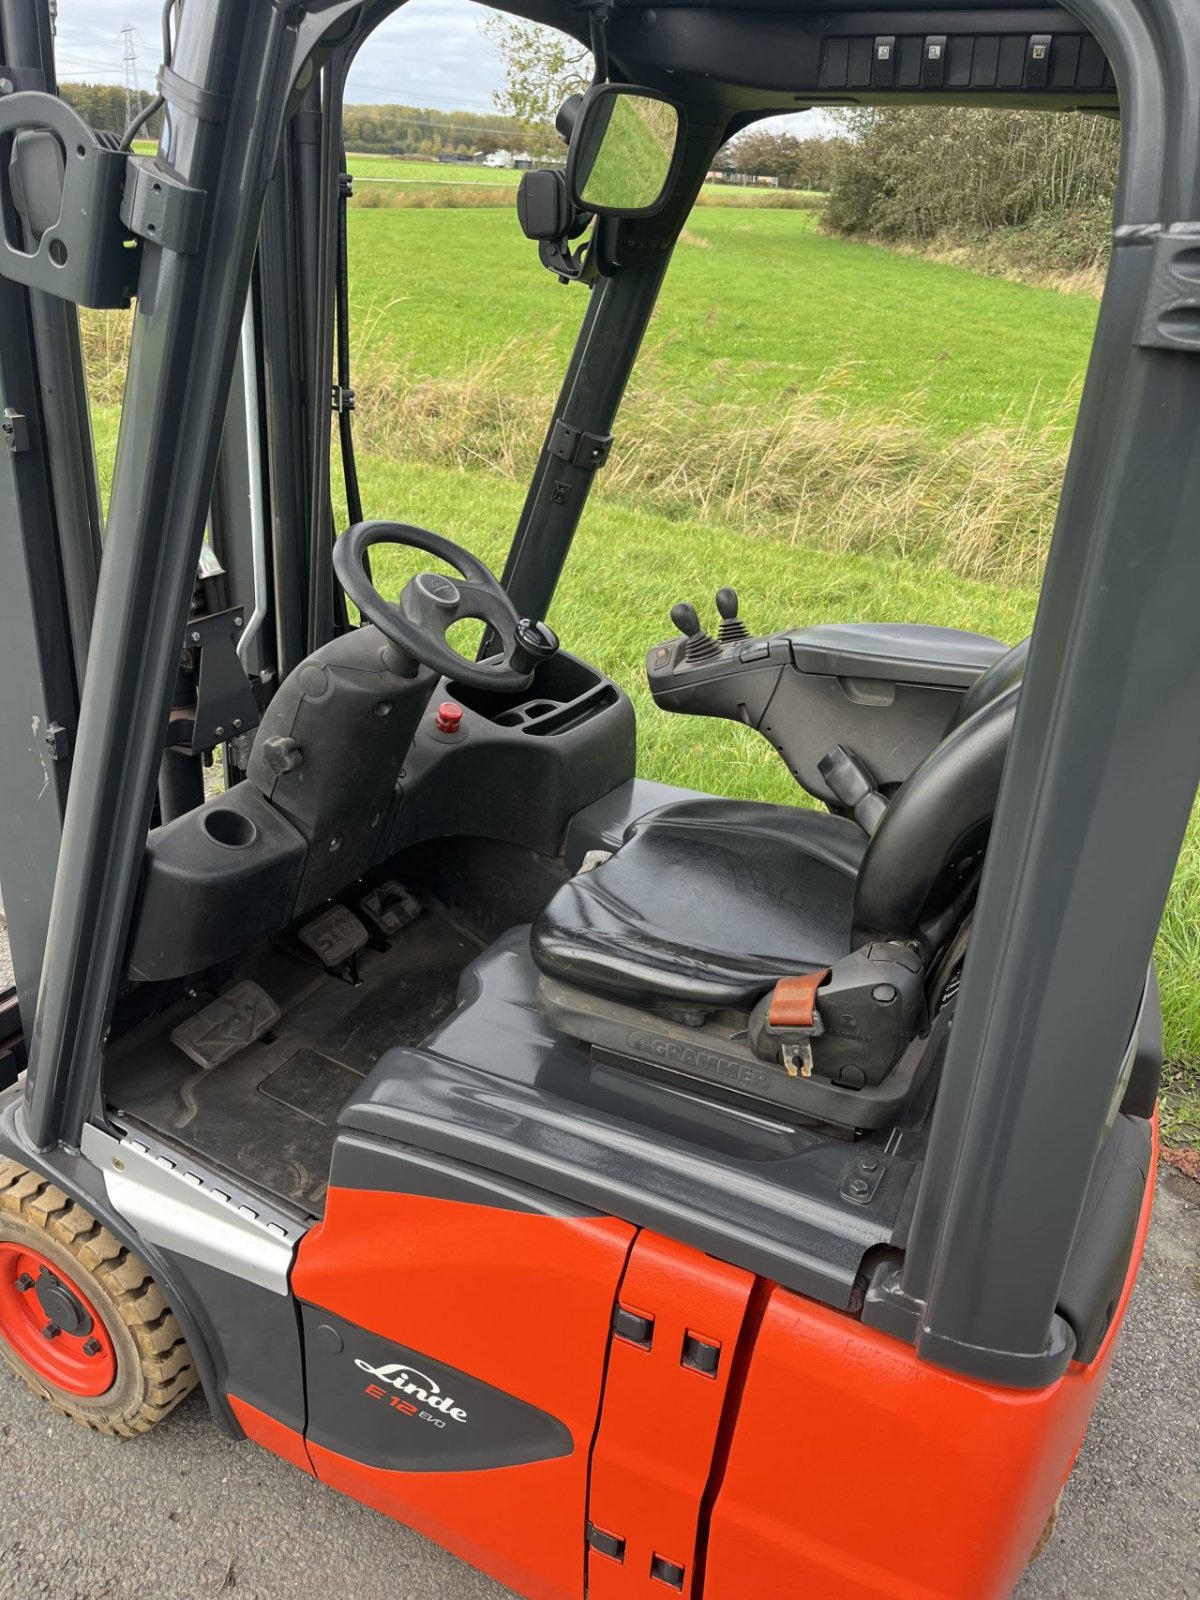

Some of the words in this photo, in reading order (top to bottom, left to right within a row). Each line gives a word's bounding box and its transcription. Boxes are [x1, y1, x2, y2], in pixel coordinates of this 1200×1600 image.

[651, 1039, 770, 1090] GRAMMER
[354, 1358, 467, 1423] Linde
[364, 1383, 387, 1400] E
[389, 1395, 418, 1417] 12
[418, 1410, 446, 1428] EVO
